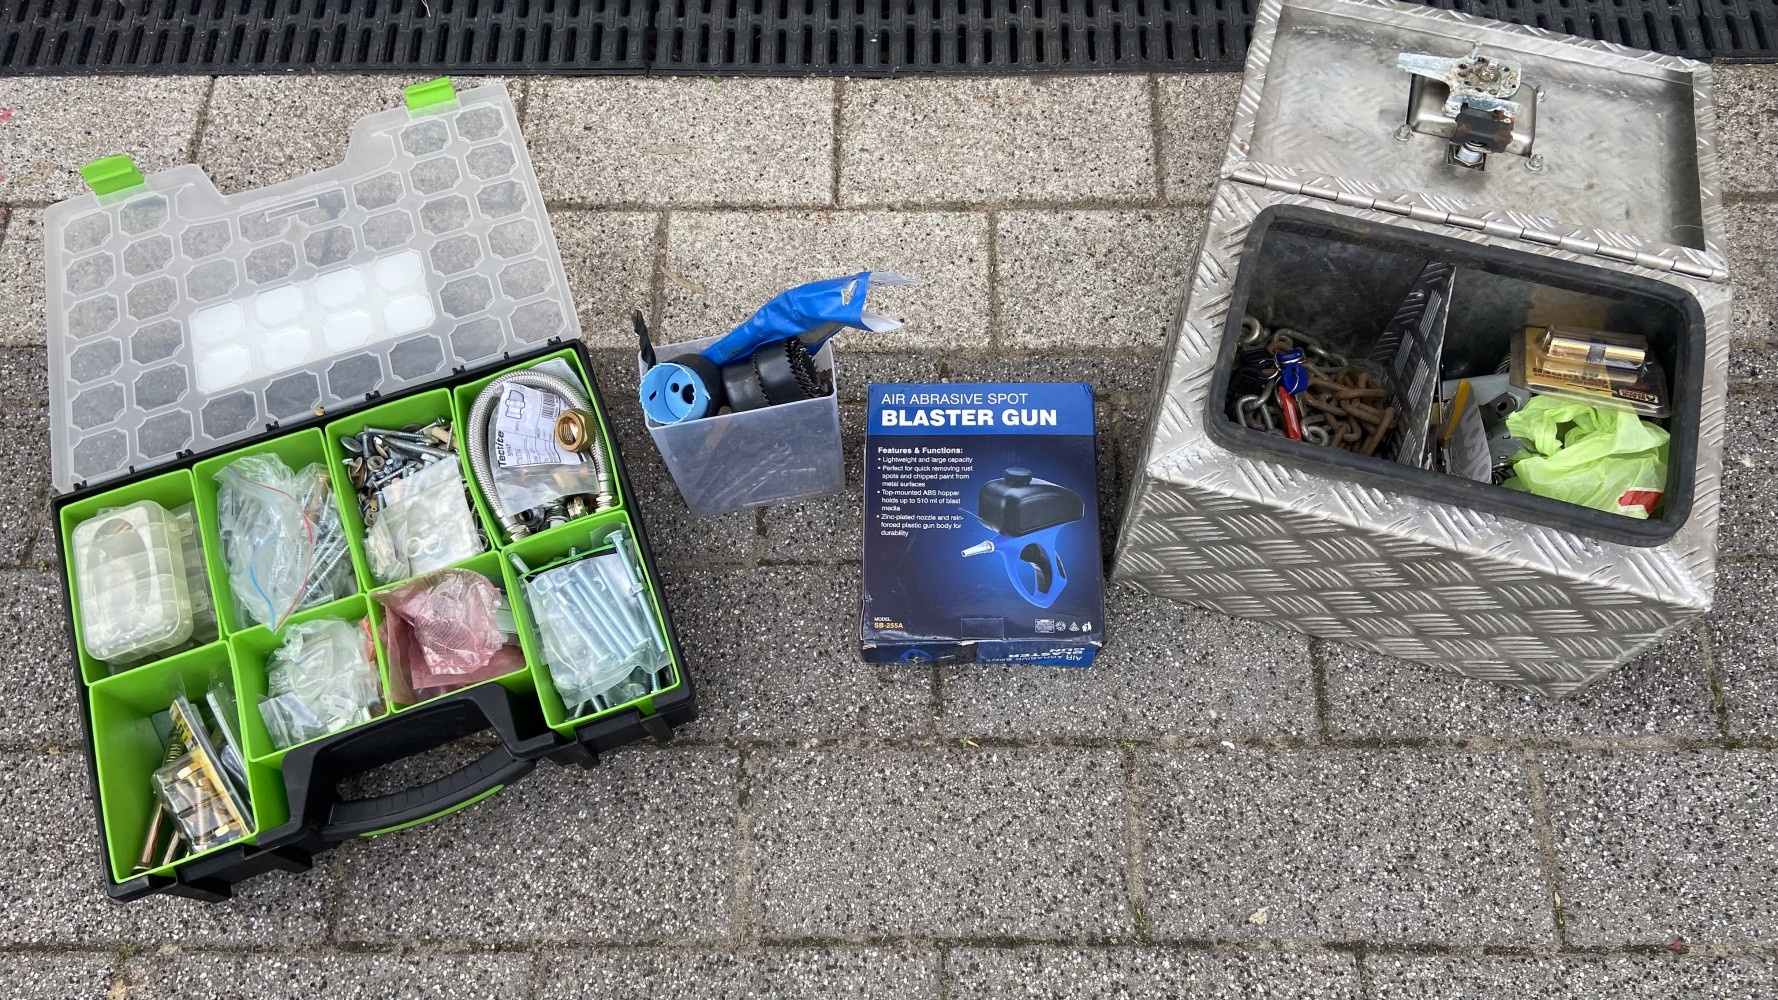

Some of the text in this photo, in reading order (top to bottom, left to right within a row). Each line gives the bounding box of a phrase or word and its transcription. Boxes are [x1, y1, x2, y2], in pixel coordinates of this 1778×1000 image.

[881, 393, 1029, 405] AIR ABRASIVE SPOT
[881, 409, 1057, 426] BLASTER GUN
[936, 522, 952, 530] body
